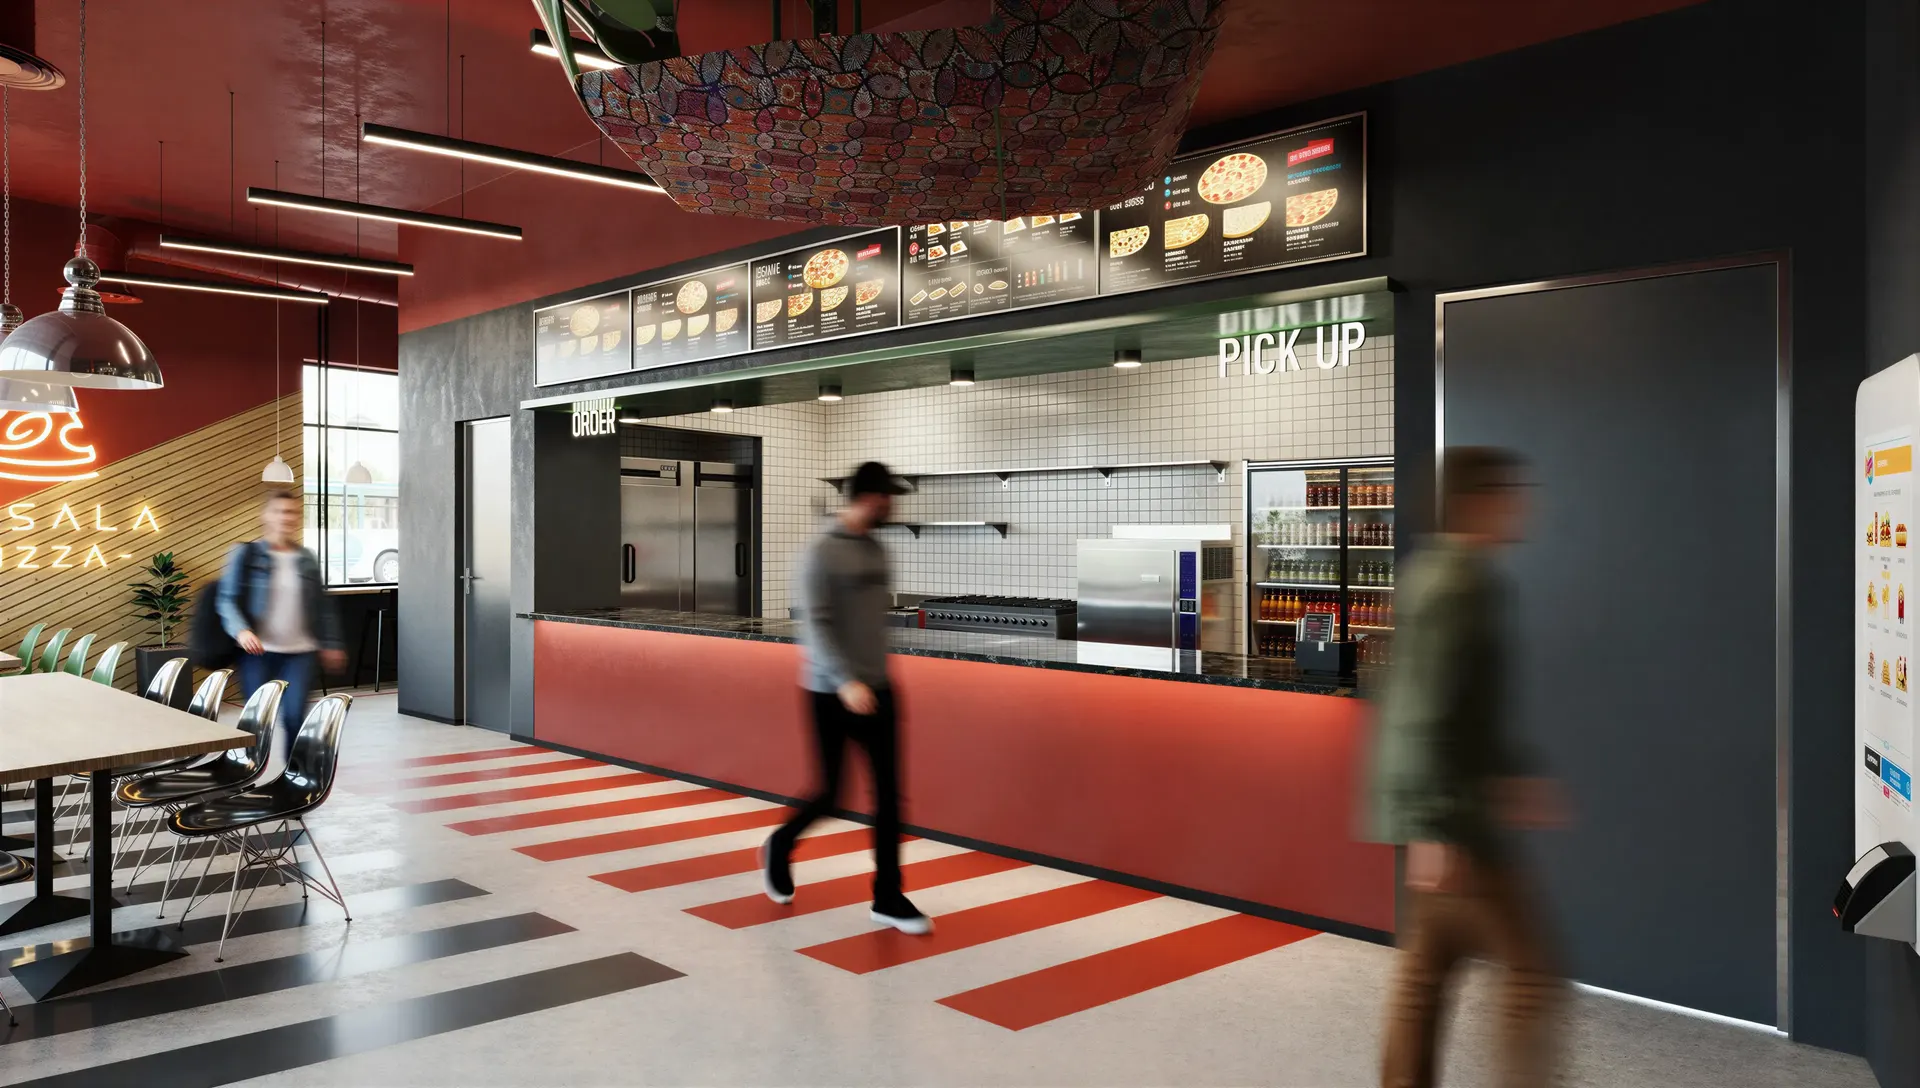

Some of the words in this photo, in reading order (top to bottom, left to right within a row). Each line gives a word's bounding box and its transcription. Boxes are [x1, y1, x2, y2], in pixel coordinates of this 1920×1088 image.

[1219, 328, 1302, 378] PICK
[1316, 321, 1366, 369] UP
[572, 408, 616, 437] ORDER
[8, 503, 159, 532] SALA
